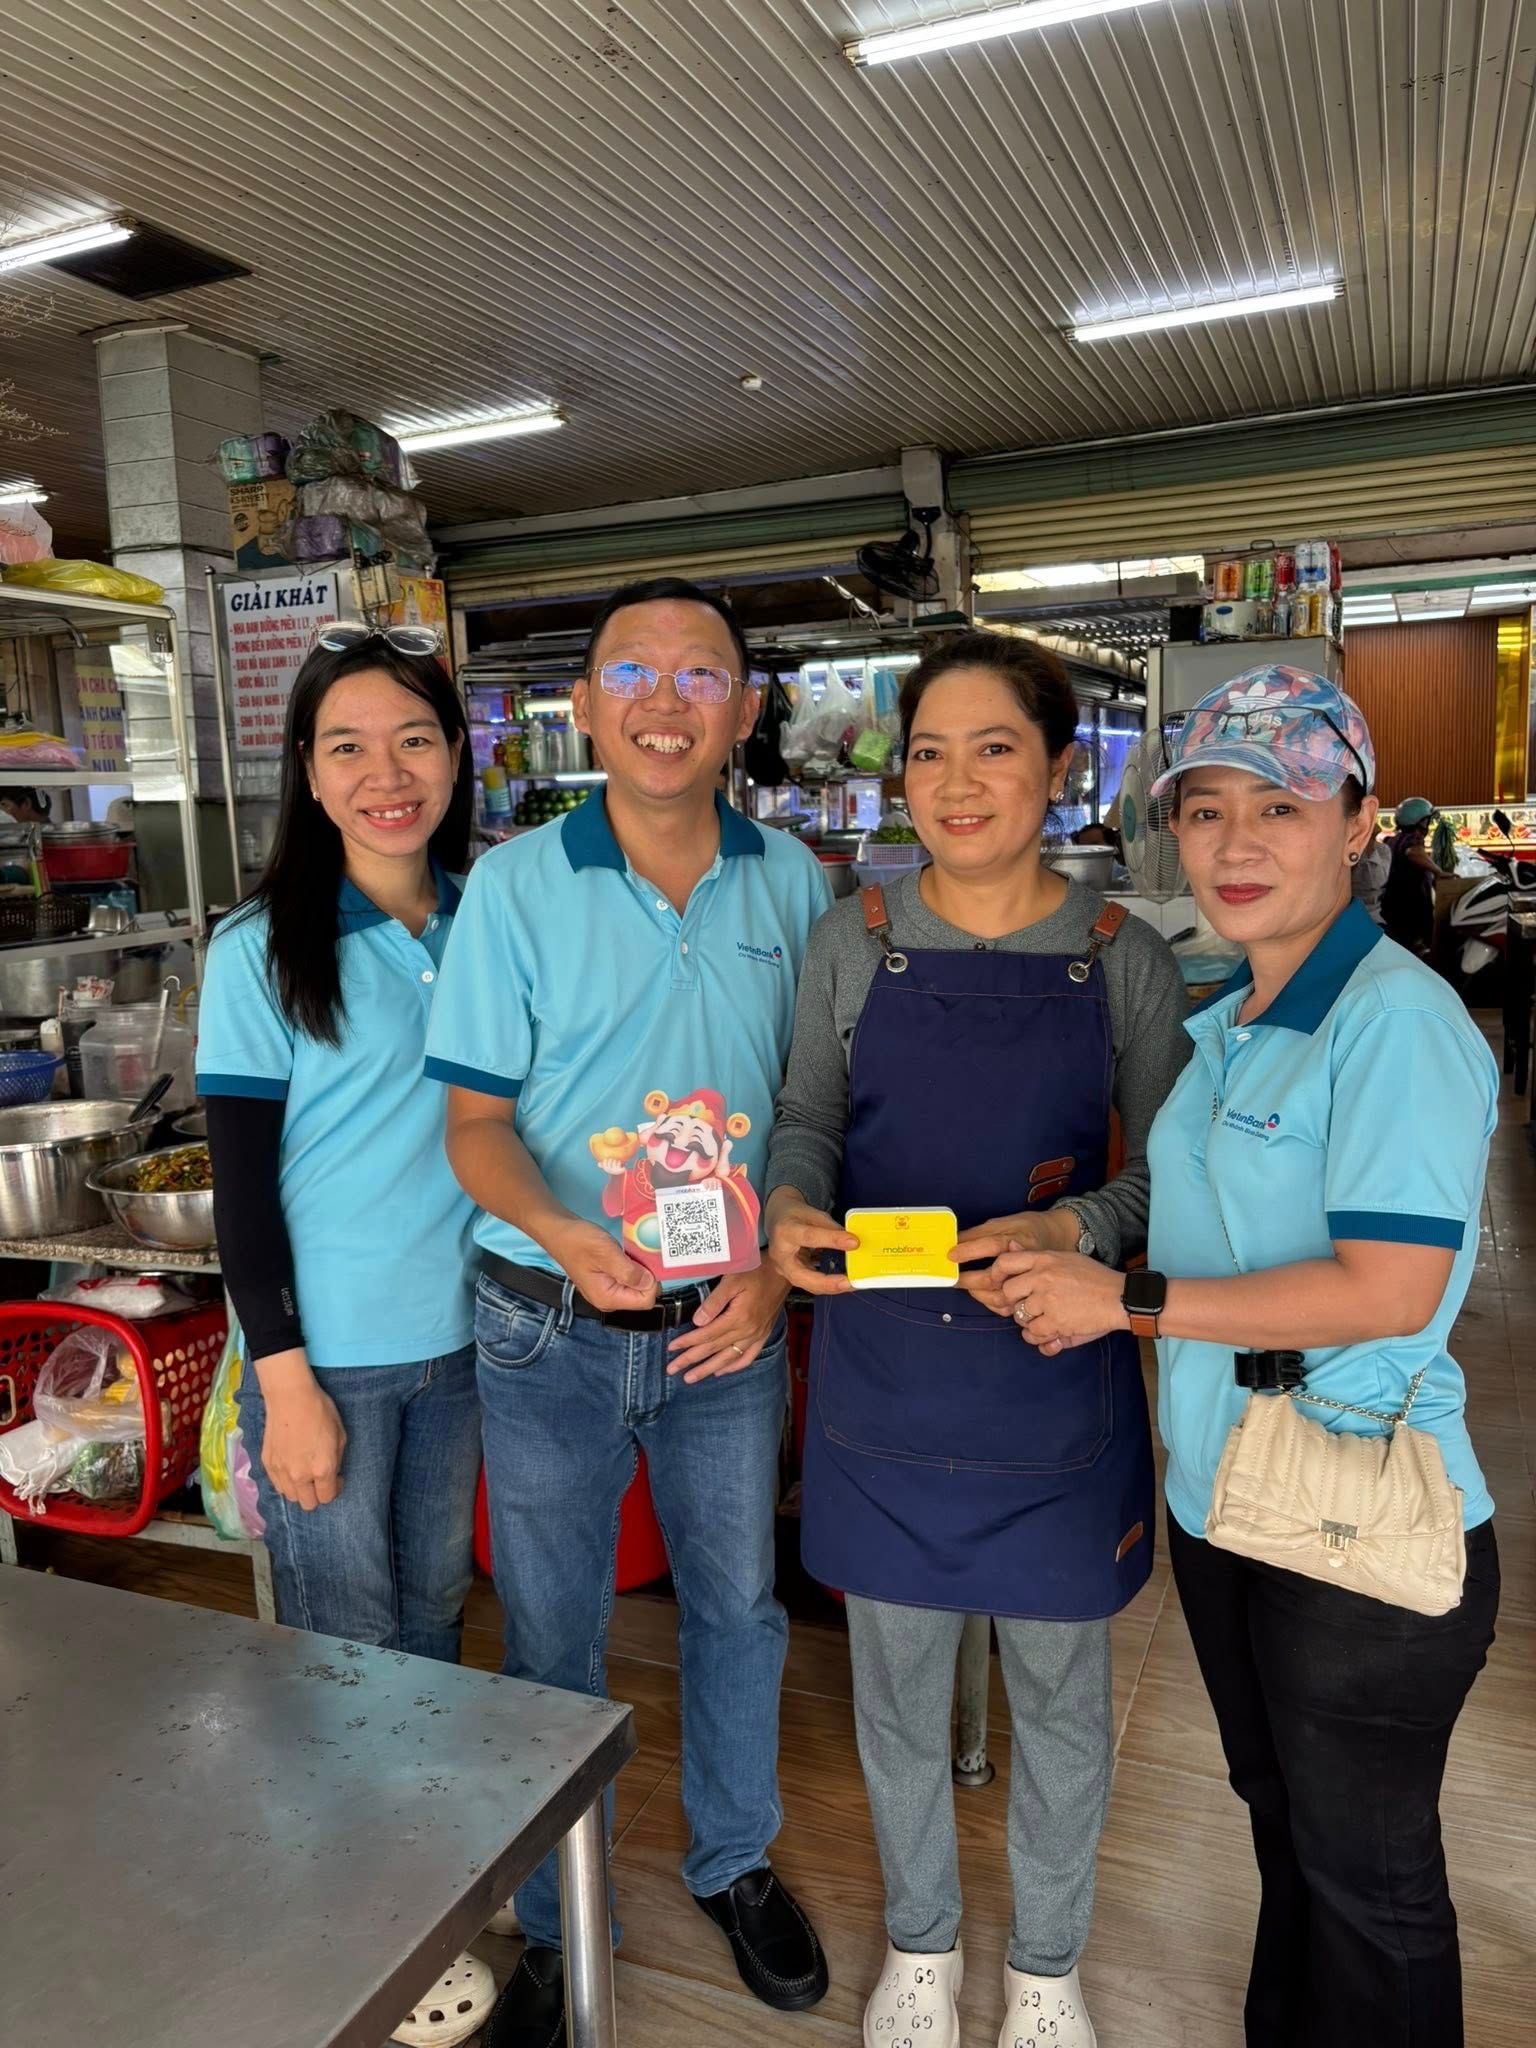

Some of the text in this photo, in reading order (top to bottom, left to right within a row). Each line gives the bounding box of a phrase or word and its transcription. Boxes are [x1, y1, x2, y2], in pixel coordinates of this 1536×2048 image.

[230, 485, 264, 496] SHARP
[231, 580, 328, 612] GIẢI KHÁT
[1226, 1108, 1267, 1130] VietinBank
[882, 1245, 925, 1254] mobifone
